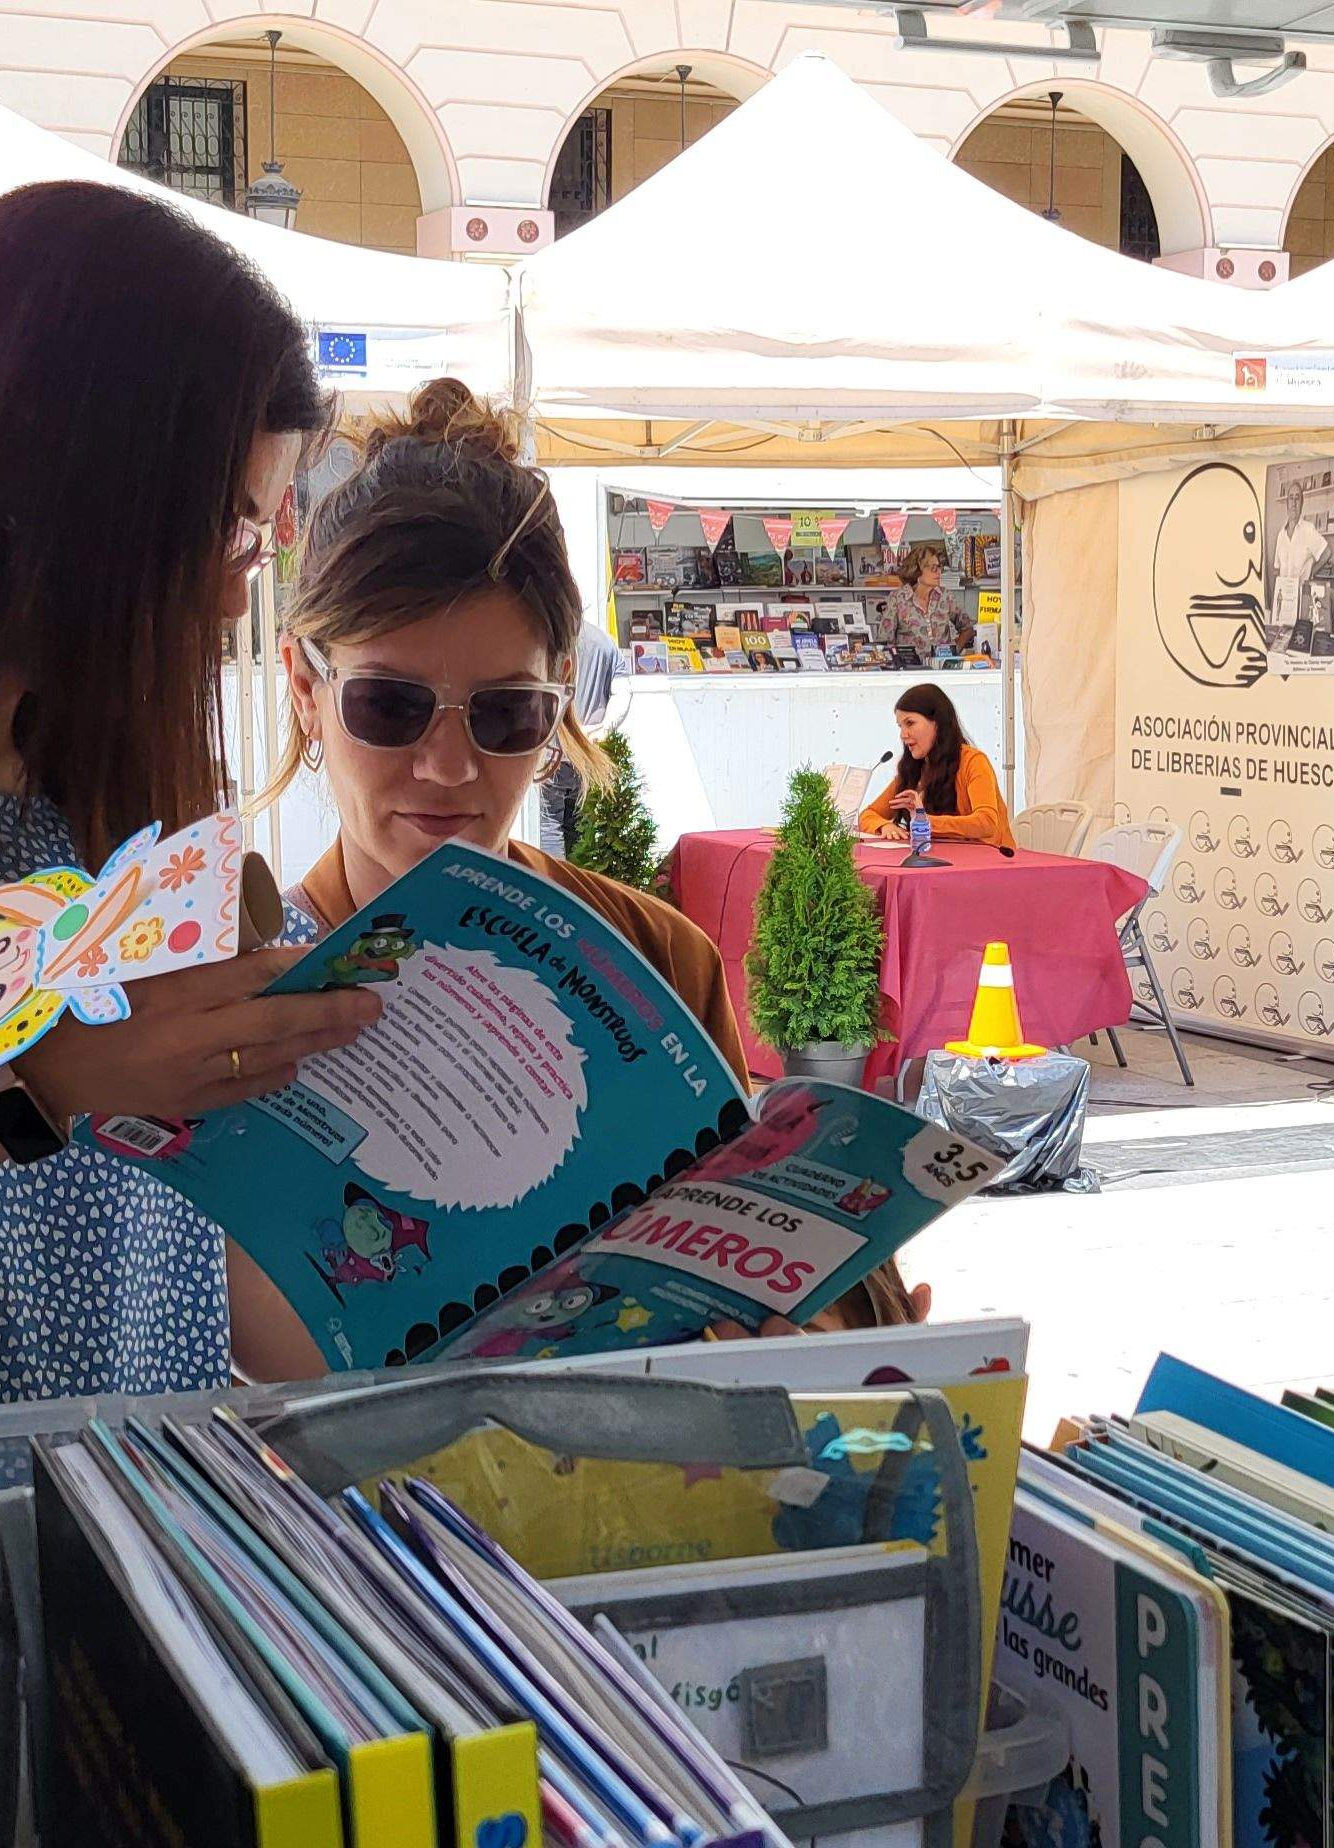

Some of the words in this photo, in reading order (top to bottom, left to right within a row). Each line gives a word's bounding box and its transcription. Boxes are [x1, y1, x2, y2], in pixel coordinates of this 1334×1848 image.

[1131, 714, 1231, 744] ASOCIACIÓN
[1131, 748, 1153, 771] DE
[1156, 750, 1242, 780] LIBRERIAS
[1246, 759, 1268, 782] DE
[458, 905, 553, 965] ESCUELA
[442, 863, 536, 911] APRENDE
[534, 905, 578, 939] LOS
[577, 936, 665, 1032] NÚMEROS
[660, 1031, 690, 1064] EN
[683, 1065, 709, 1098] LA
[548, 956, 568, 975] de
[532, 1026, 546, 1040] de
[557, 965, 648, 1064] MONSTRUOS
[922, 1162, 956, 1189] AÑOS
[934, 1142, 989, 1183] 3-5
[660, 1186, 759, 1217] APRENDE
[755, 1207, 803, 1234] LOS
[602, 1205, 816, 1294] ÚMEROS
[1003, 1615, 1029, 1660] las
[1033, 1646, 1108, 1712] grandes
